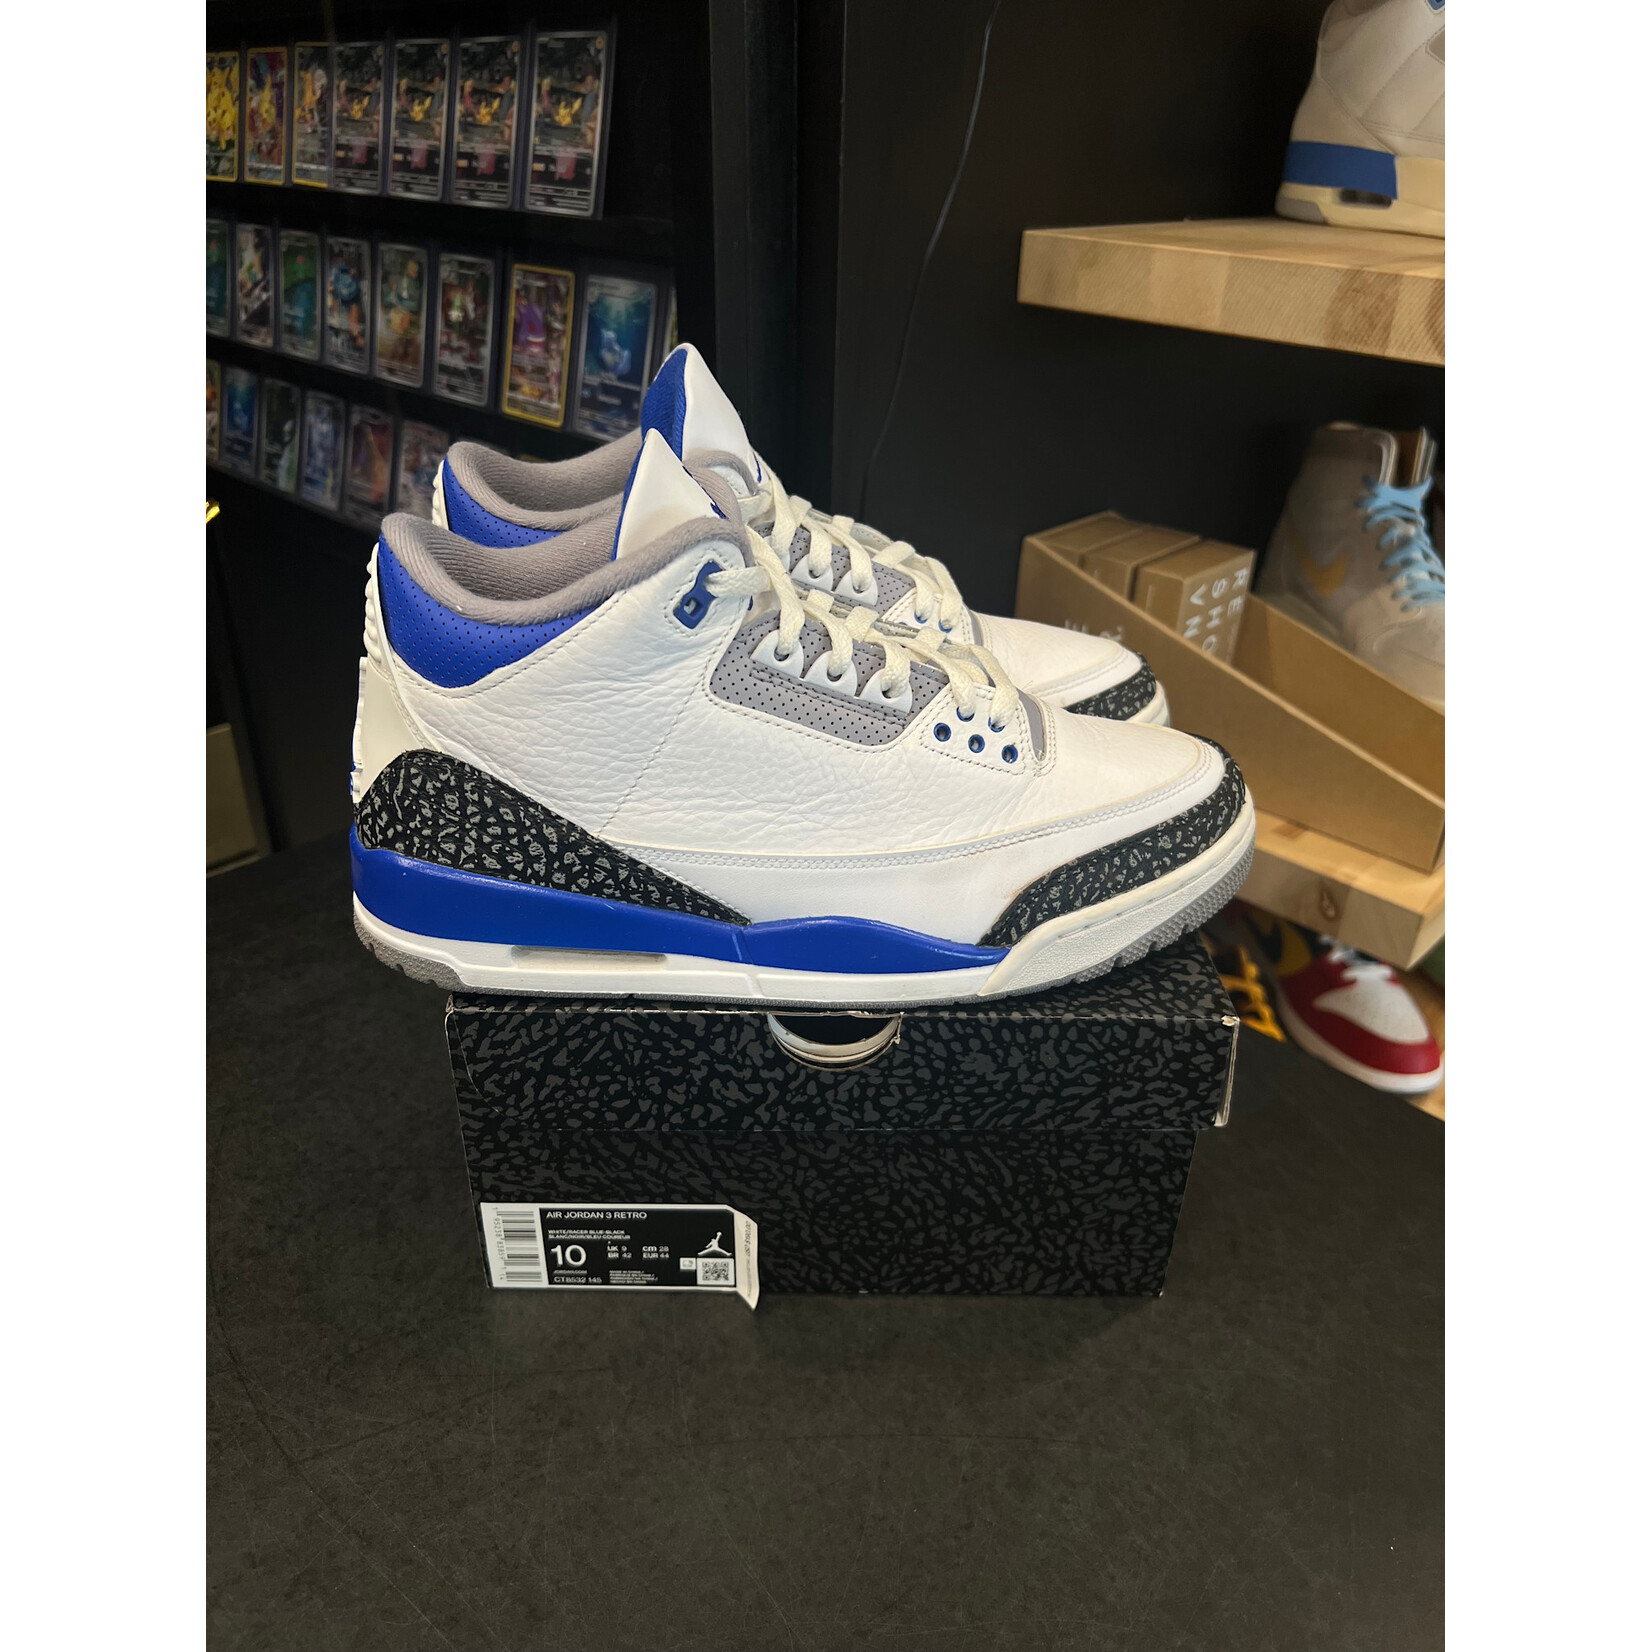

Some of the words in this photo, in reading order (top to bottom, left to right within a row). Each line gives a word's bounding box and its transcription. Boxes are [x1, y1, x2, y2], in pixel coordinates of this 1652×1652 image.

[546, 1211, 562, 1219] AIR
[564, 1211, 604, 1219] JORDAN
[605, 1211, 612, 1219] 3
[614, 1211, 648, 1219] RETRO
[550, 1244, 587, 1267] 10
